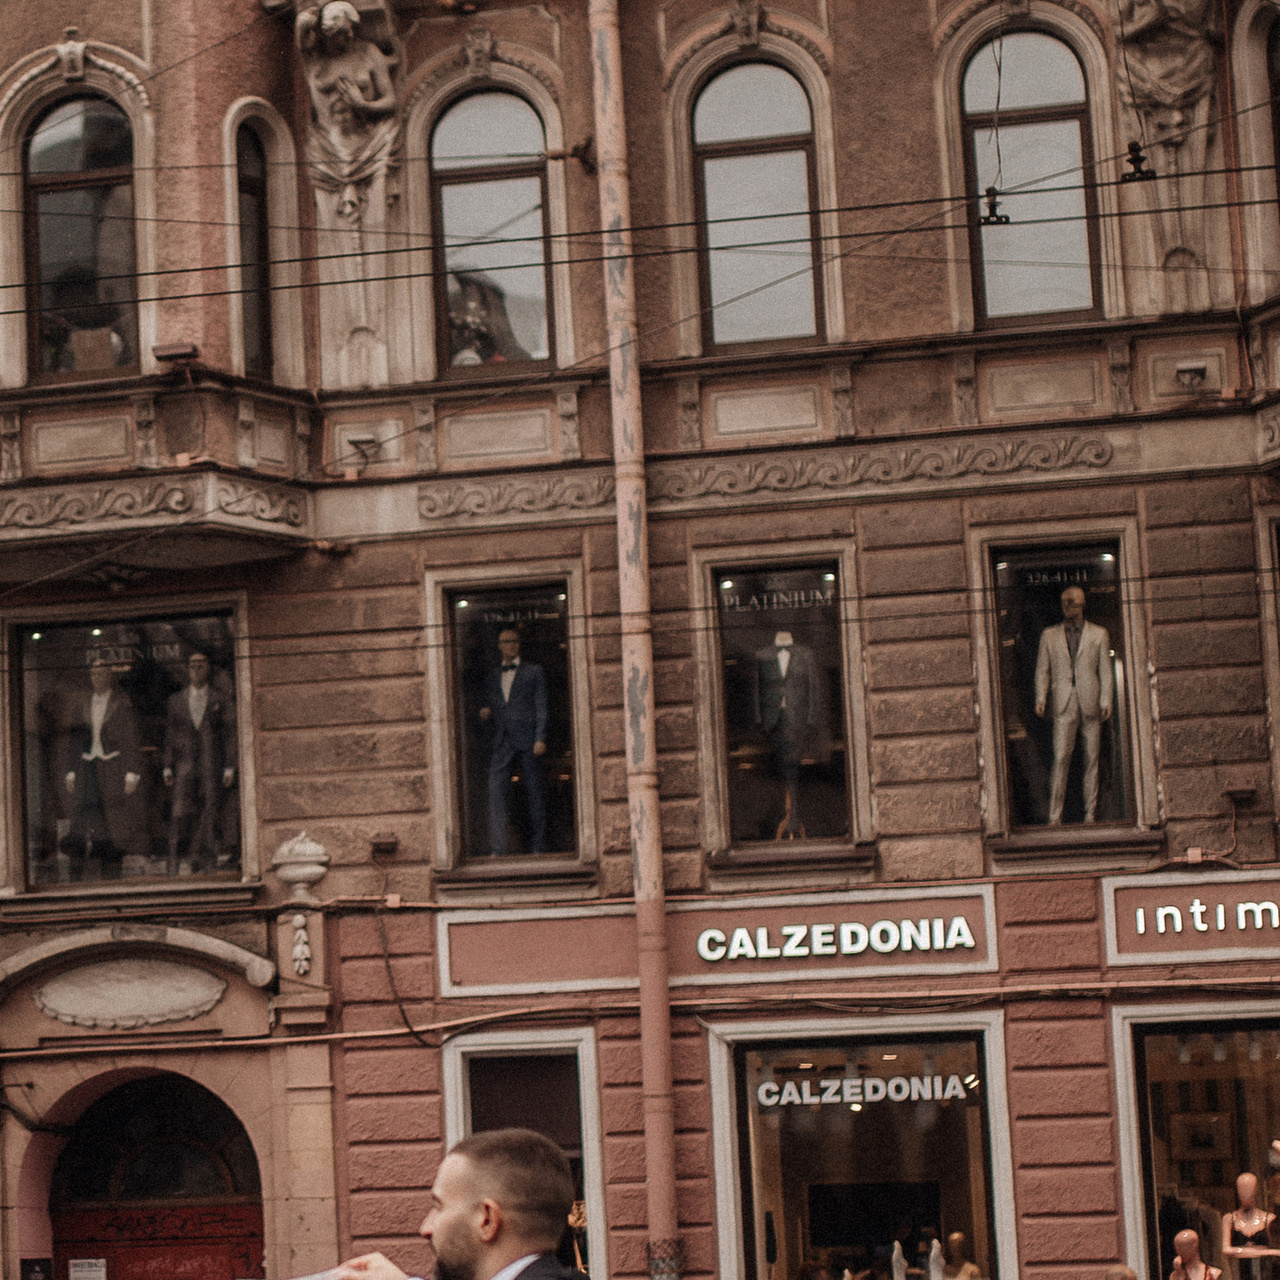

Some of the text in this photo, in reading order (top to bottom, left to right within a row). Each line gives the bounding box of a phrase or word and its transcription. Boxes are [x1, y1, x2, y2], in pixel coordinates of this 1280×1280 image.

[722, 590, 833, 612] PLATINIUM
[696, 915, 976, 962] CALZEDONIA
[757, 1074, 967, 1107] CALZEDONIA
